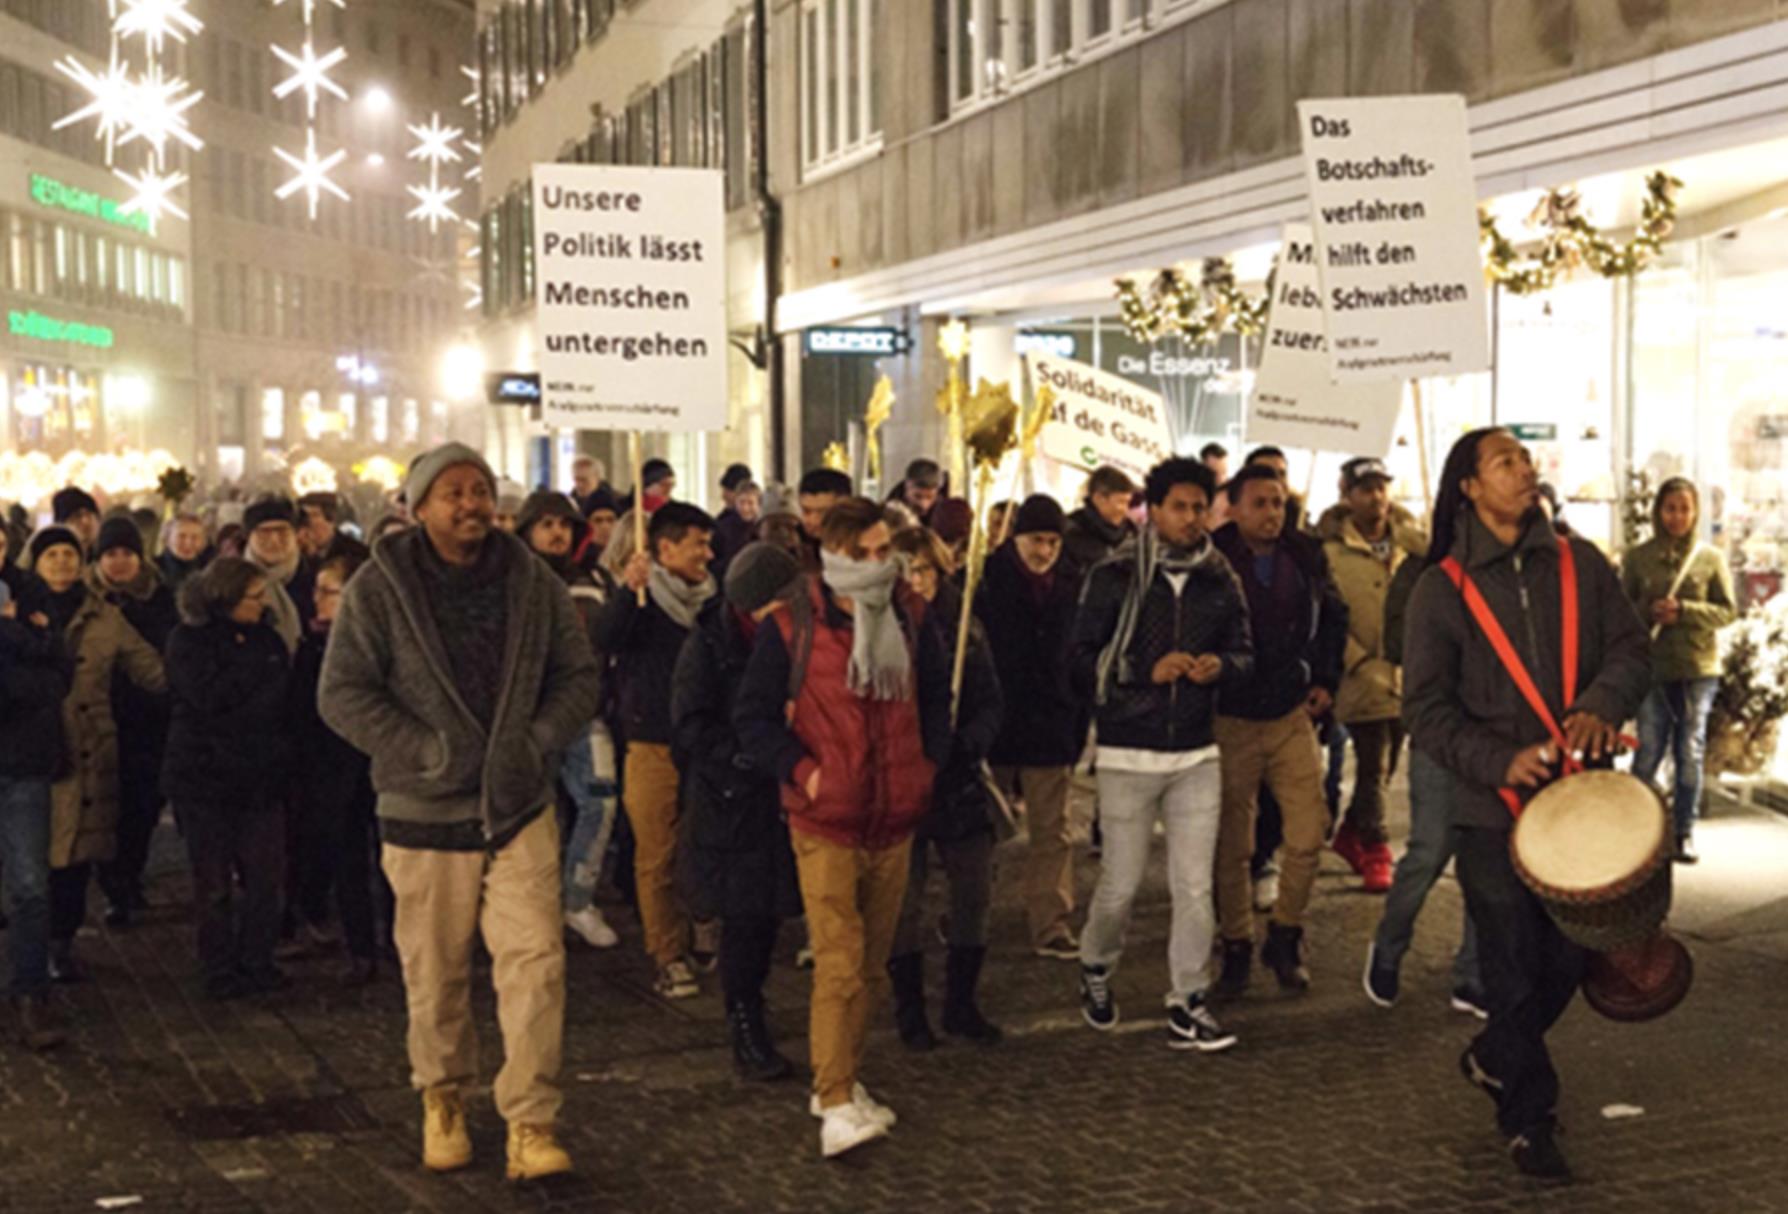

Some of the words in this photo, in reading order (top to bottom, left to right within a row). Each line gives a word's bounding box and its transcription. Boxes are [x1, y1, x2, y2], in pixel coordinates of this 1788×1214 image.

[1310, 115, 1351, 139] Das
[1316, 154, 1435, 181] Botschafts-
[542, 186, 642, 212] Unsere
[1321, 200, 1426, 225] verfahren
[543, 232, 632, 259] Politik
[640, 234, 703, 262] lässt
[1327, 242, 1373, 267] hilft
[1376, 242, 1416, 265] den
[544, 281, 690, 310] Menschen
[1330, 281, 1468, 312] Schwächsten
[545, 331, 709, 361] untergehen
[1036, 360, 1158, 424] Solidarität
[1074, 408, 1105, 437] de
